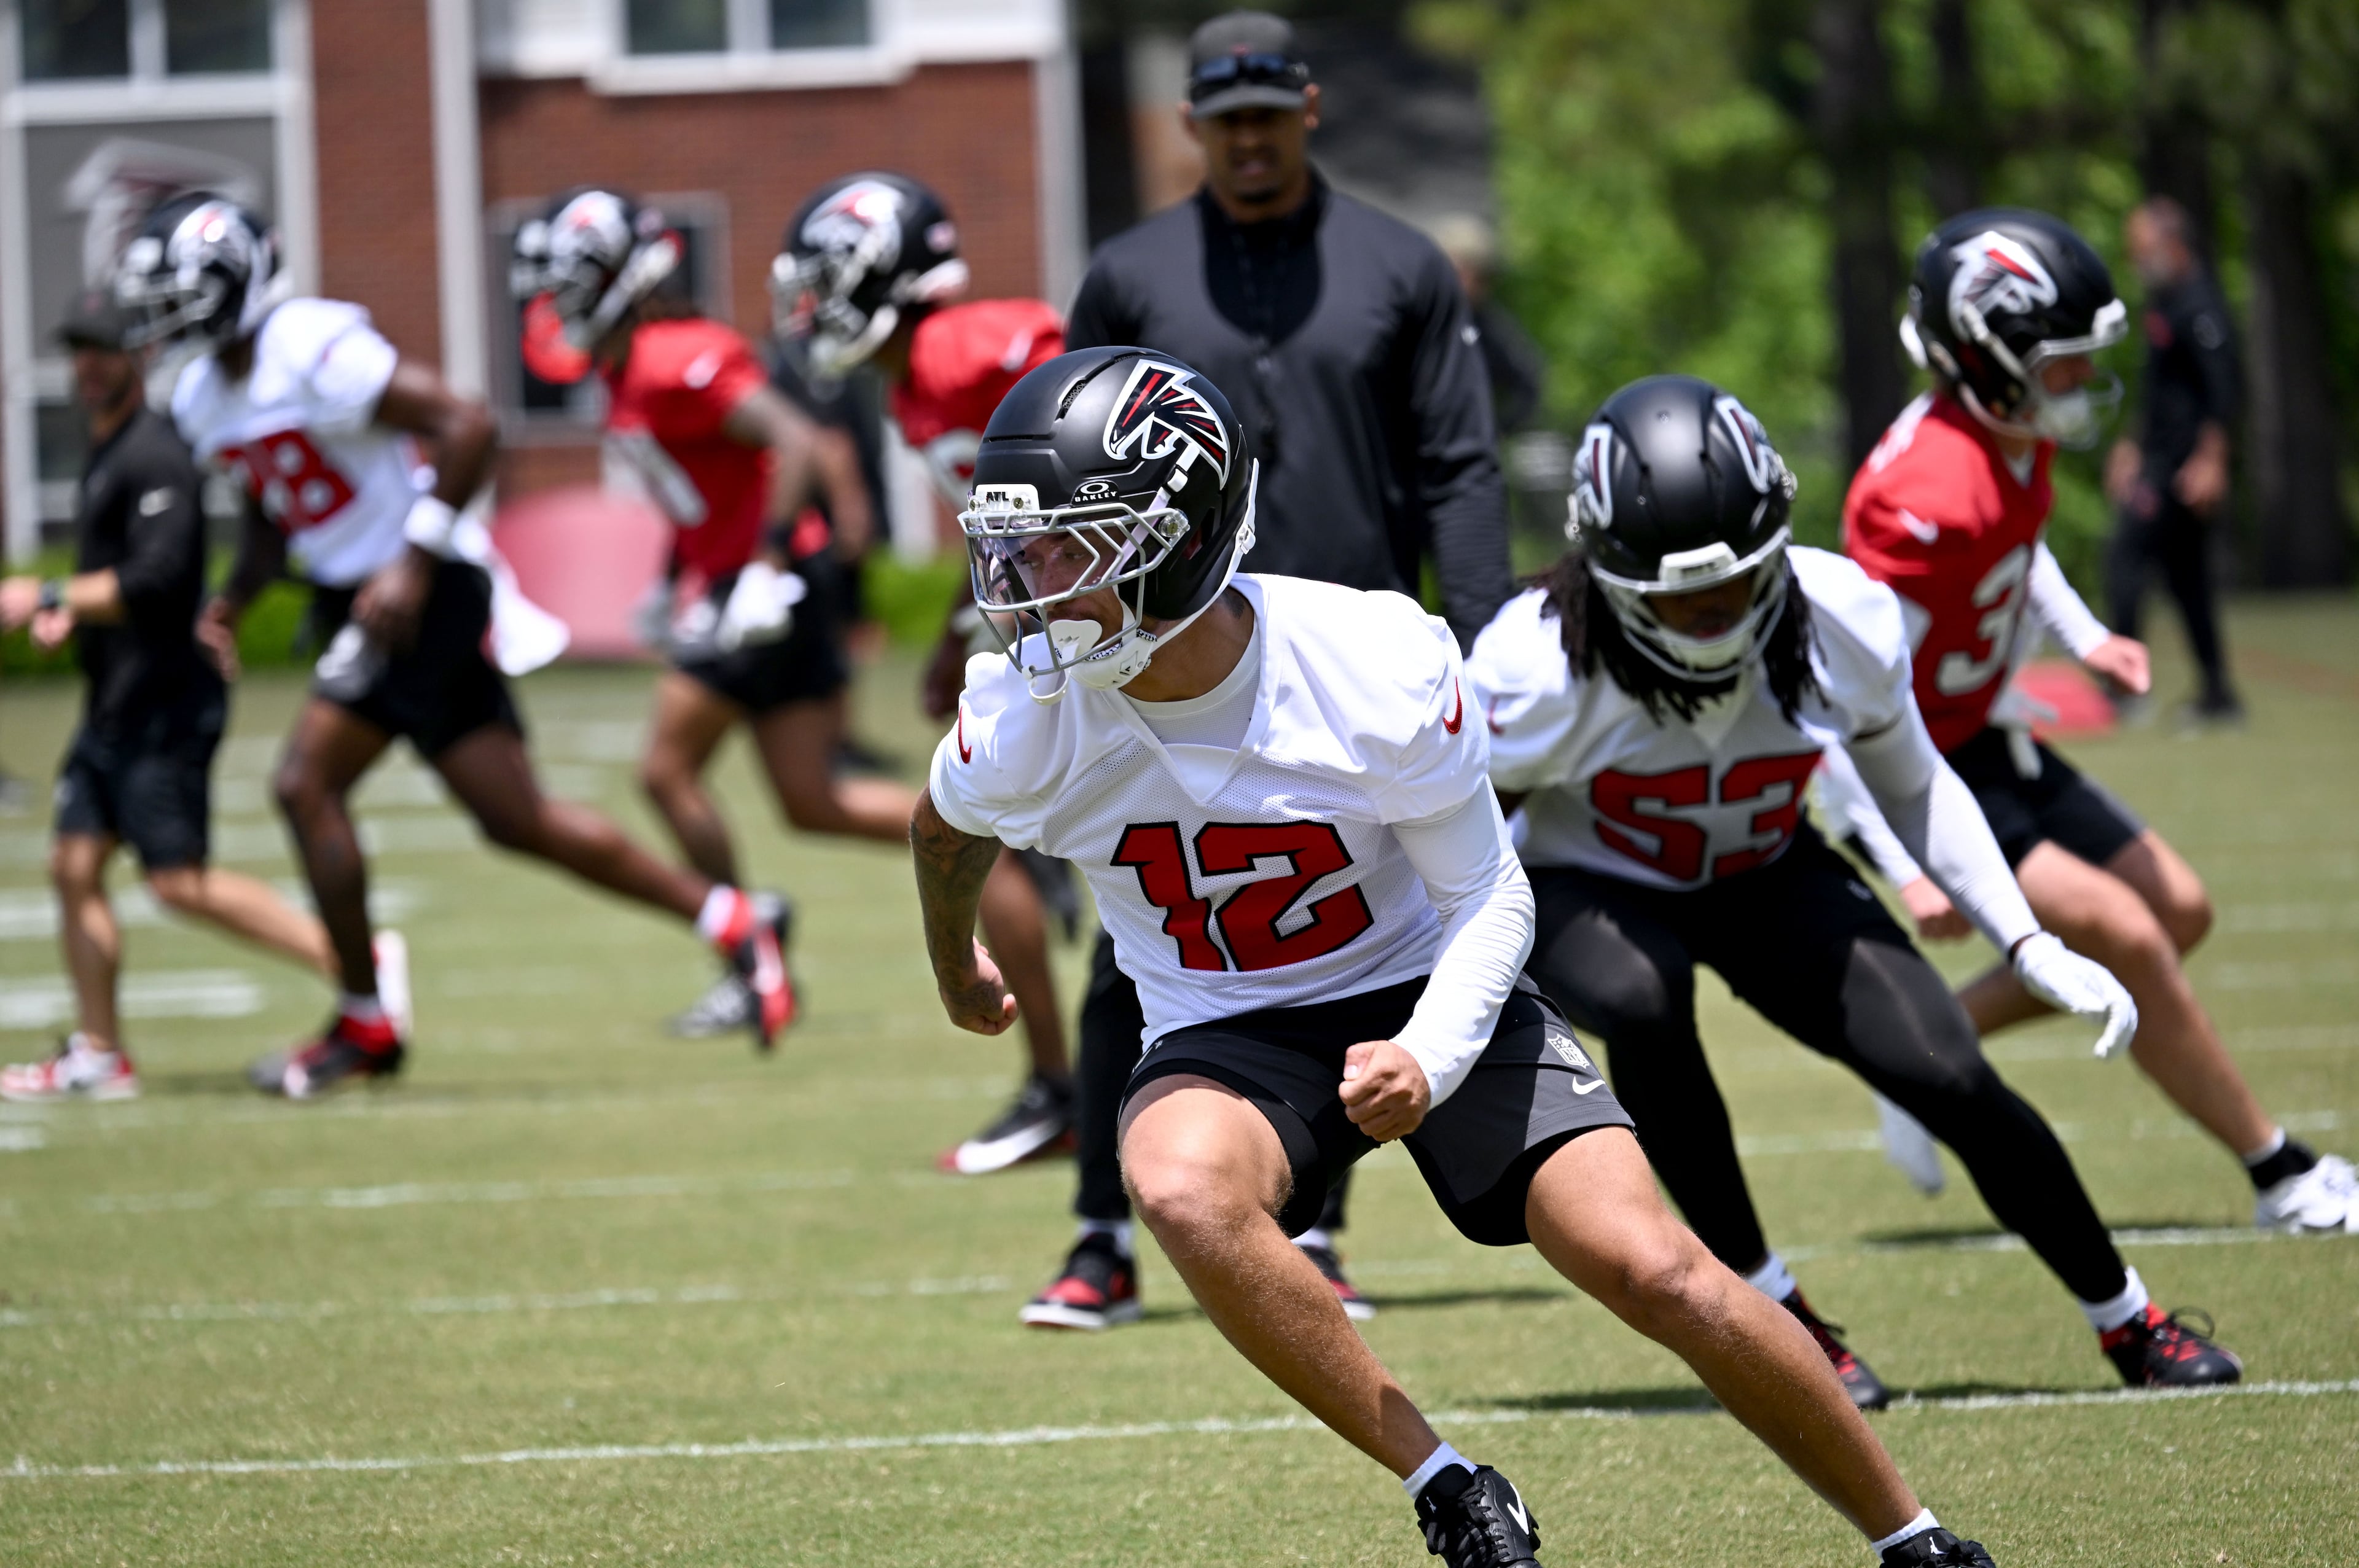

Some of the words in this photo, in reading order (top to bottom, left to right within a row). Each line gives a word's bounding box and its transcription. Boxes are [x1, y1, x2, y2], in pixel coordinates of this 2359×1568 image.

[986, 491, 1009, 502] ATL
[1074, 491, 1117, 502] OAKLEY
[1590, 749, 1824, 881] 53
[1110, 820, 1374, 972] 12
